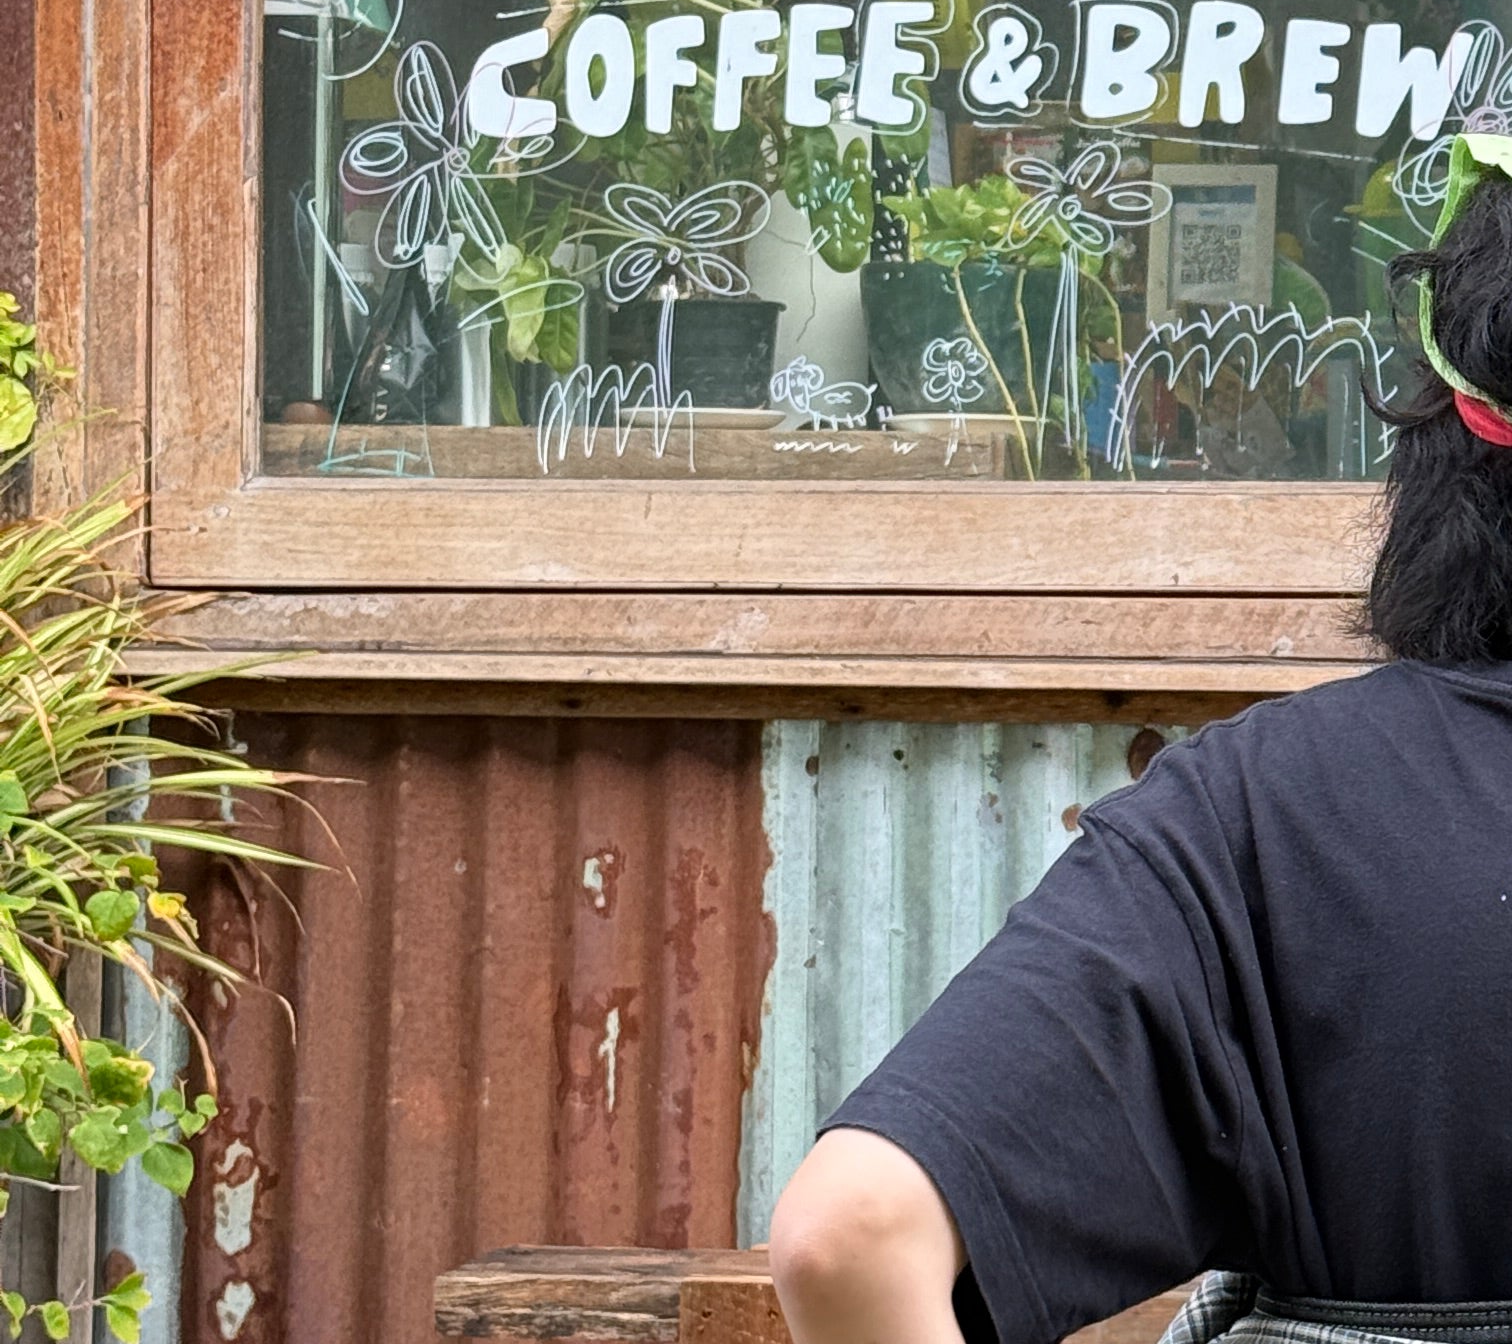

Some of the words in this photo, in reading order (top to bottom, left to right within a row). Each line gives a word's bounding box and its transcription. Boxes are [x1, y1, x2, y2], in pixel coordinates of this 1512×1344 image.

[468, 0, 935, 139] COFFEE
[970, 17, 1042, 107] &
[1081, 1, 1475, 141] BREW
